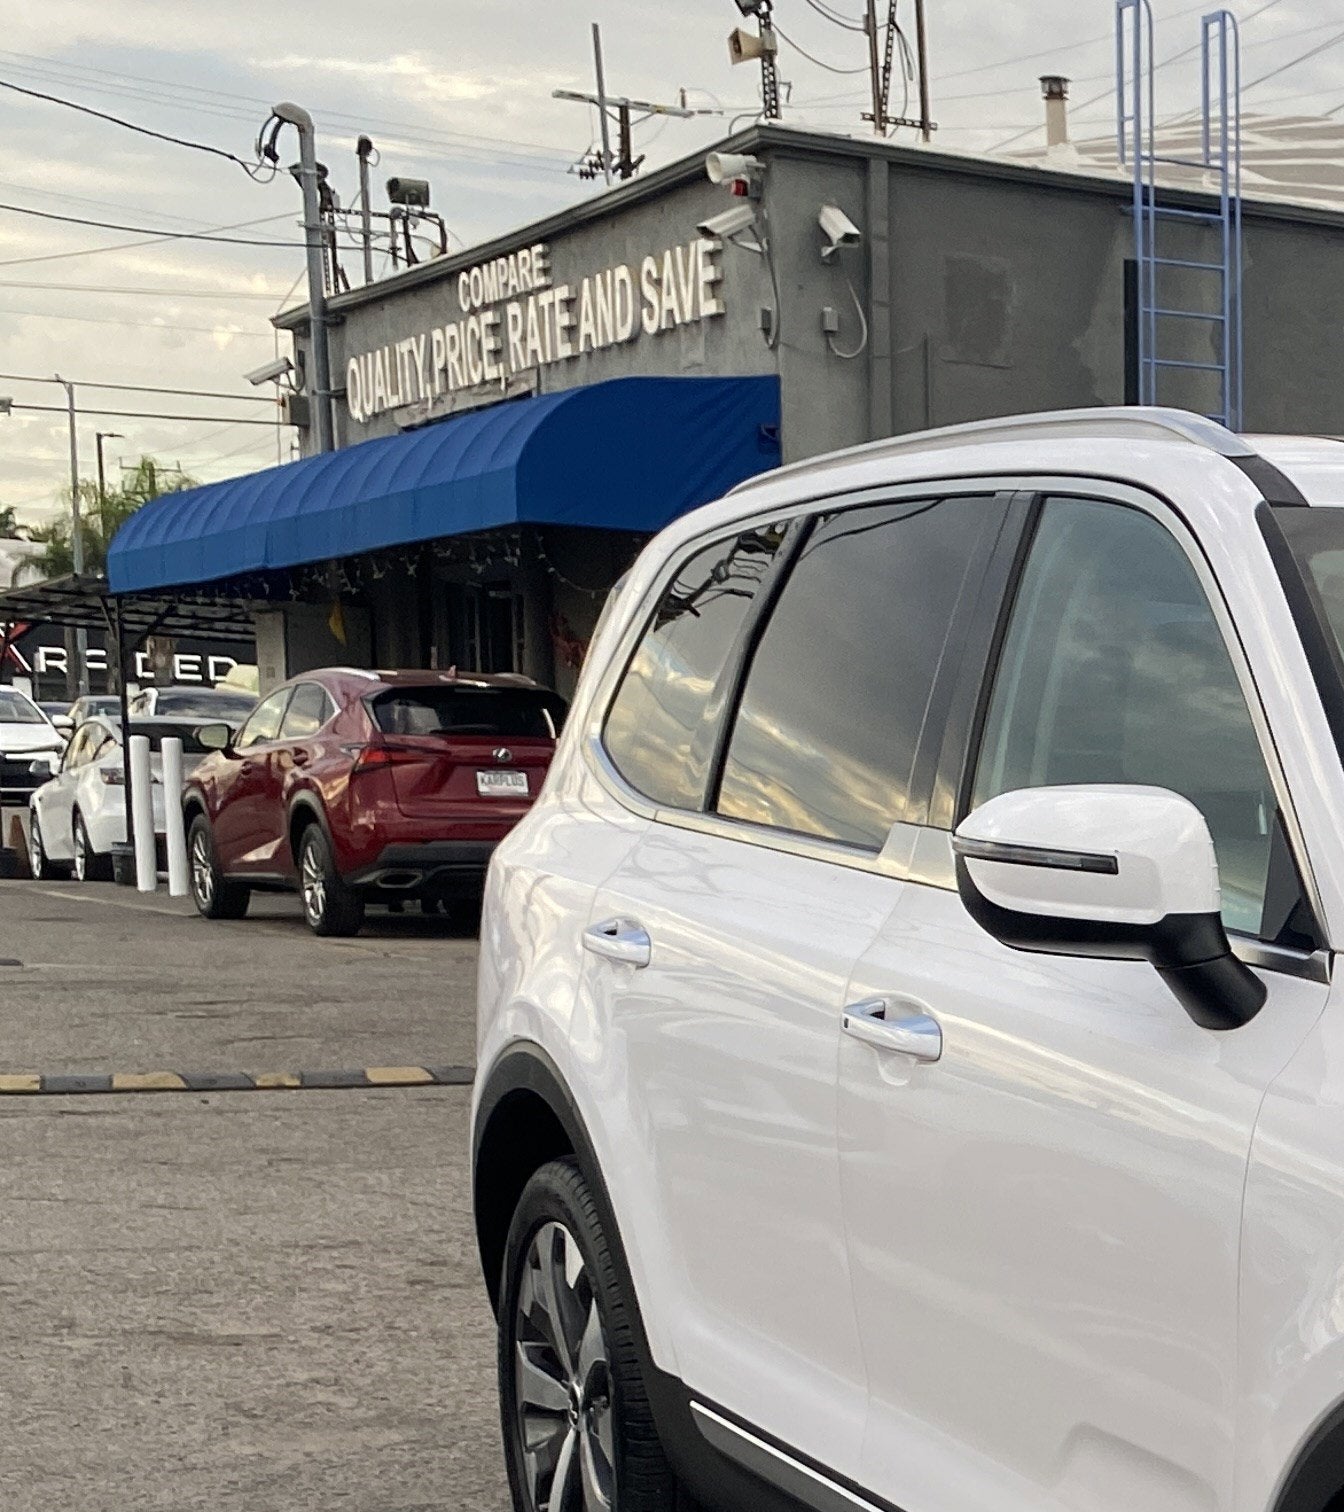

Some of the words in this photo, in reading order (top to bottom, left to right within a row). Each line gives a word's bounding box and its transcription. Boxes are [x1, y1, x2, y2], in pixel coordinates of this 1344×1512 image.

[458, 243, 548, 312] COMPARE
[506, 284, 575, 373] RATE
[578, 263, 638, 352] AND
[641, 238, 724, 335] SAVE
